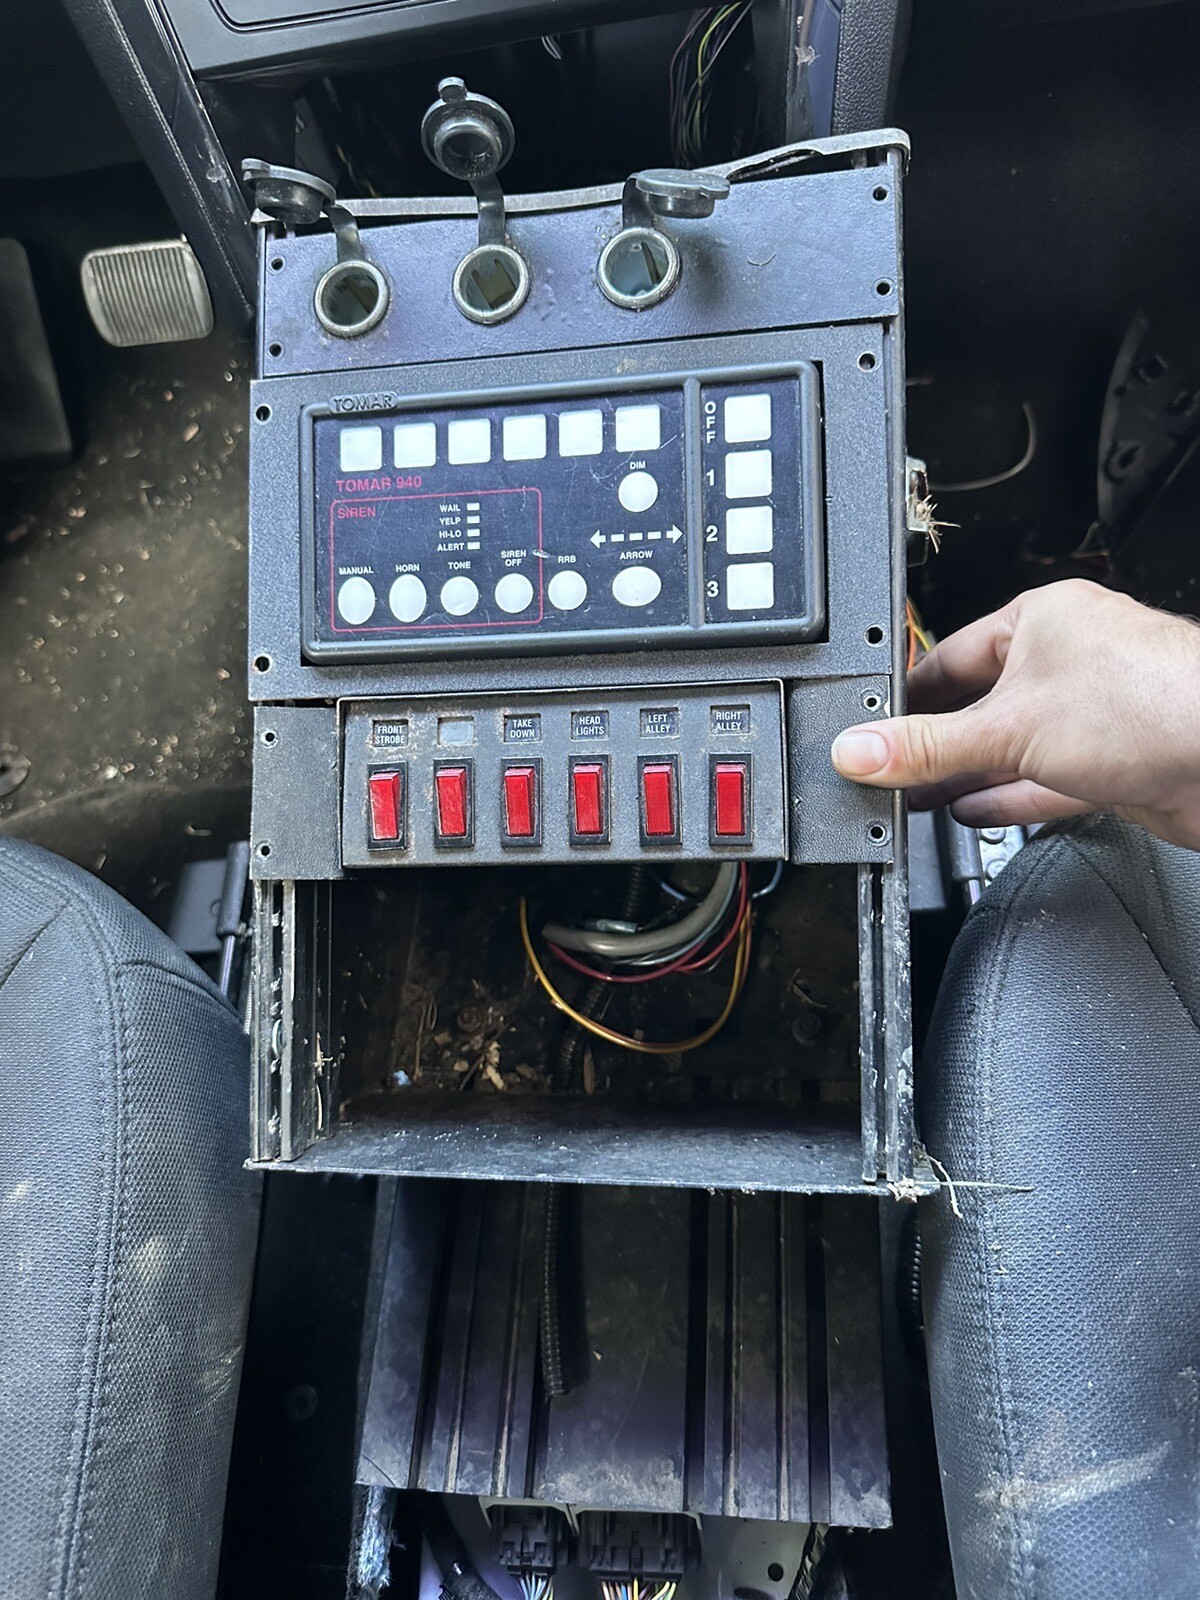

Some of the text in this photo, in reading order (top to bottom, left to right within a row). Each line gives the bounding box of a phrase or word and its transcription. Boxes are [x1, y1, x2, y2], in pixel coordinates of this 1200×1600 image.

[333, 394, 395, 412] TOMAR
[705, 402, 717, 444] OFF
[629, 461, 646, 470] DIM
[706, 469, 715, 486] 1
[336, 475, 423, 492] TOMAR 940
[337, 506, 376, 519] SIREN
[439, 503, 461, 513] WAIL
[439, 516, 461, 526] YELP
[438, 529, 462, 539] HI-LO
[706, 525, 718, 542] 2
[436, 542, 465, 552] ALERT
[500, 549, 527, 559] SIREN
[557, 554, 577, 564] RRB
[619, 549, 654, 560] ARROW
[447, 561, 471, 570] TONE
[504, 558, 523, 567] OFF
[338, 565, 374, 575] MANUAL
[395, 563, 420, 573] HORN
[706, 581, 719, 597] 3
[579, 716, 602, 726] HEAD
[648, 713, 668, 724] LEFT
[716, 711, 742, 722] RIGHT
[512, 719, 533, 729] TAKE
[645, 723, 671, 734] ALLEY
[716, 721, 743, 731] ALLEY
[377, 725, 404, 735] FRONT
[510, 728, 535, 739] DOWN
[576, 725, 605, 736] LIGHTS
[374, 734, 406, 744] STROBE
